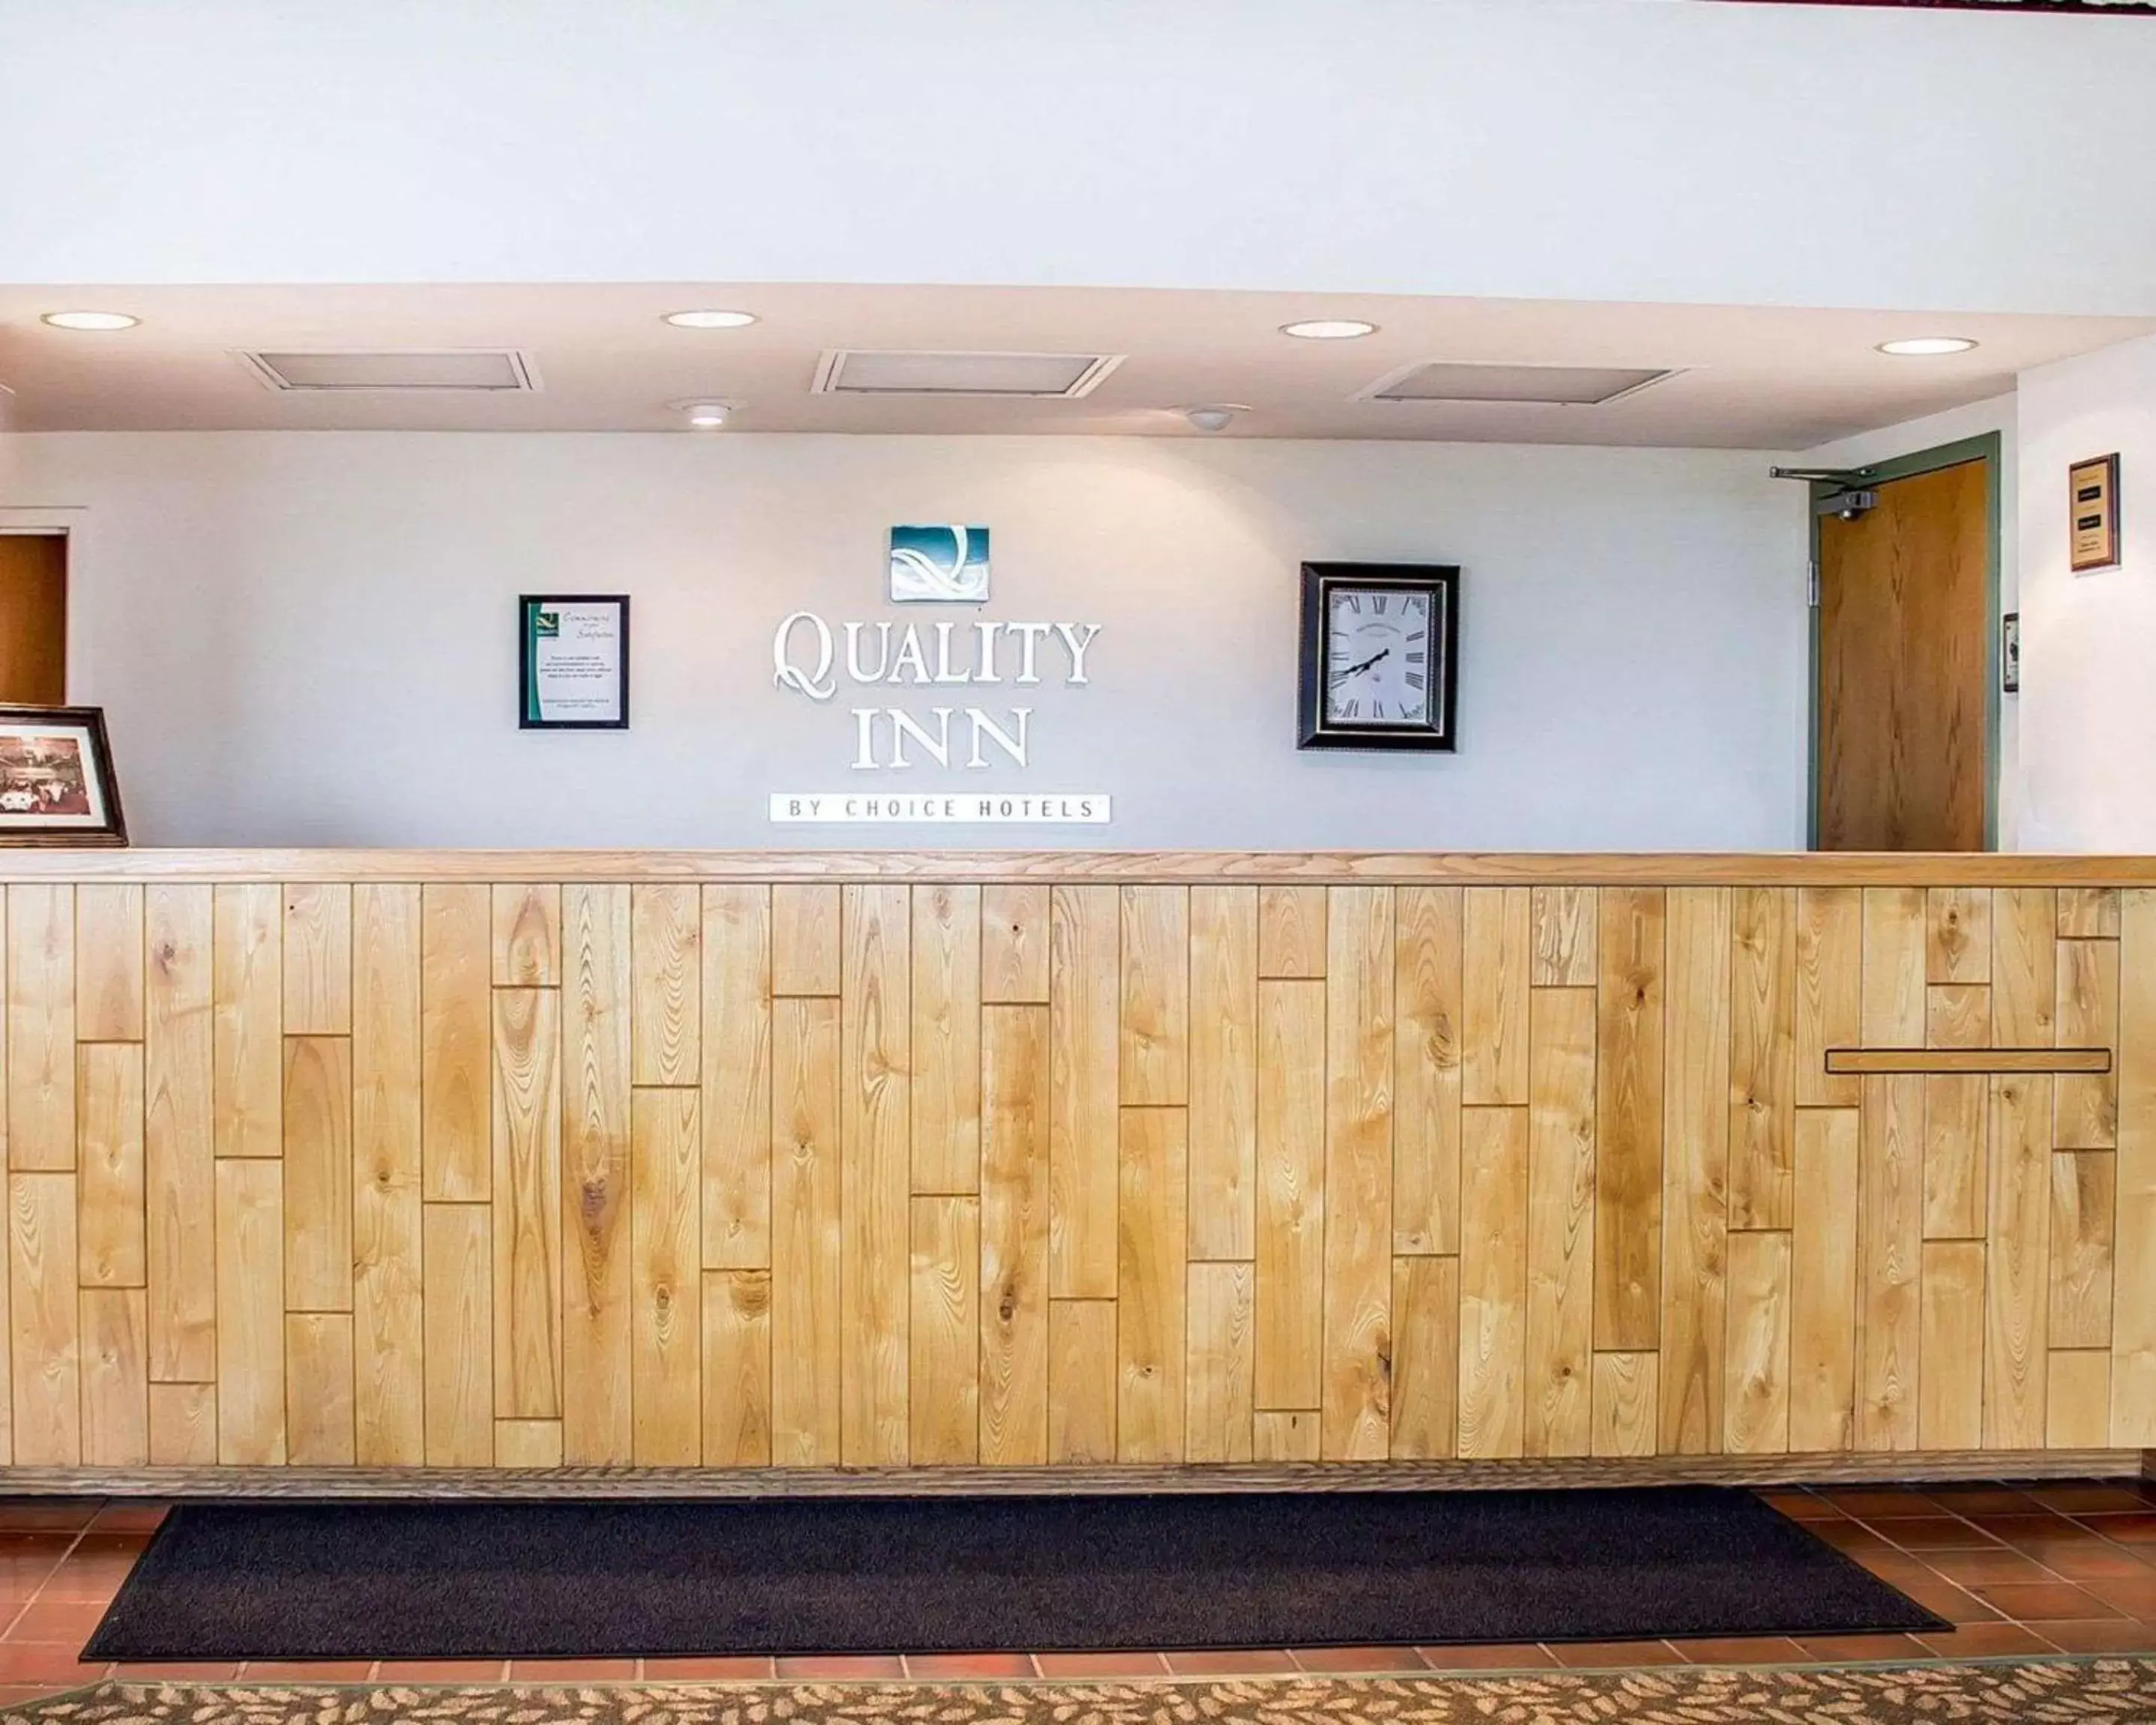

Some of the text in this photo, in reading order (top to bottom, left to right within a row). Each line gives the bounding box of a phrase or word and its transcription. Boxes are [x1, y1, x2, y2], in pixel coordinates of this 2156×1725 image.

[772, 611, 1103, 699] QUALITY
[850, 707, 1035, 770] INN
[789, 799, 1093, 818] BY CHOICE HOTELS
